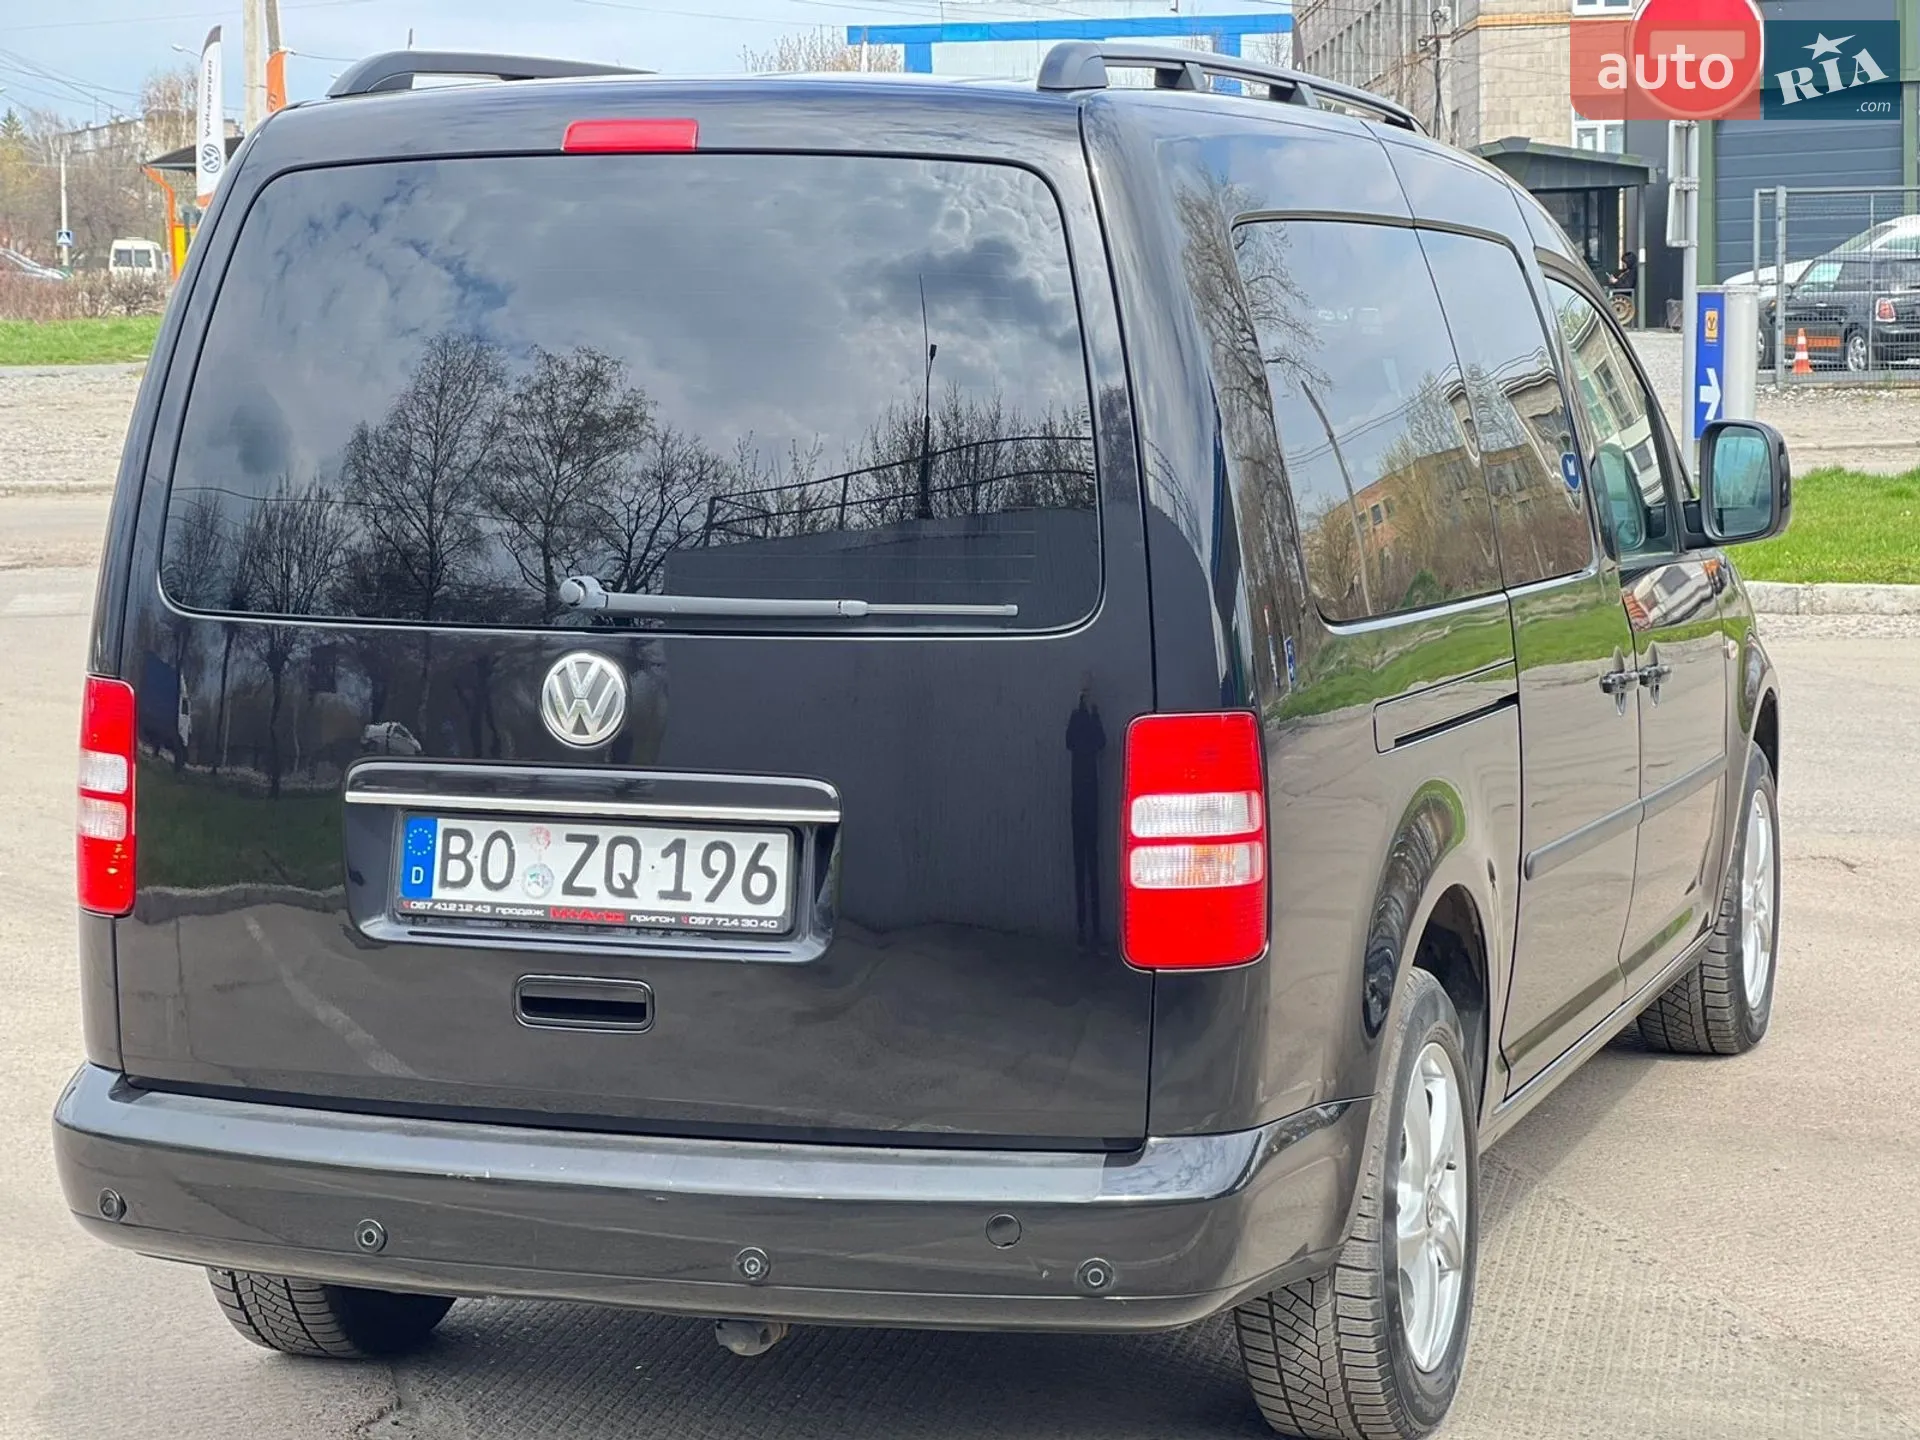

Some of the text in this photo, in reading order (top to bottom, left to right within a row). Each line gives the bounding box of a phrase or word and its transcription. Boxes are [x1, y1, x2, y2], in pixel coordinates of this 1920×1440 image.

[411, 866, 424, 884] D
[438, 827, 778, 905] BO ZQ 196
[434, 902, 457, 911] 412
[458, 903, 473, 912] 12
[474, 904, 491, 914] 43
[495, 906, 545, 917] продаж
[630, 914, 676, 923] пригон
[717, 917, 739, 926] 714
[741, 918, 759, 927] 30
[760, 919, 778, 928] 40
